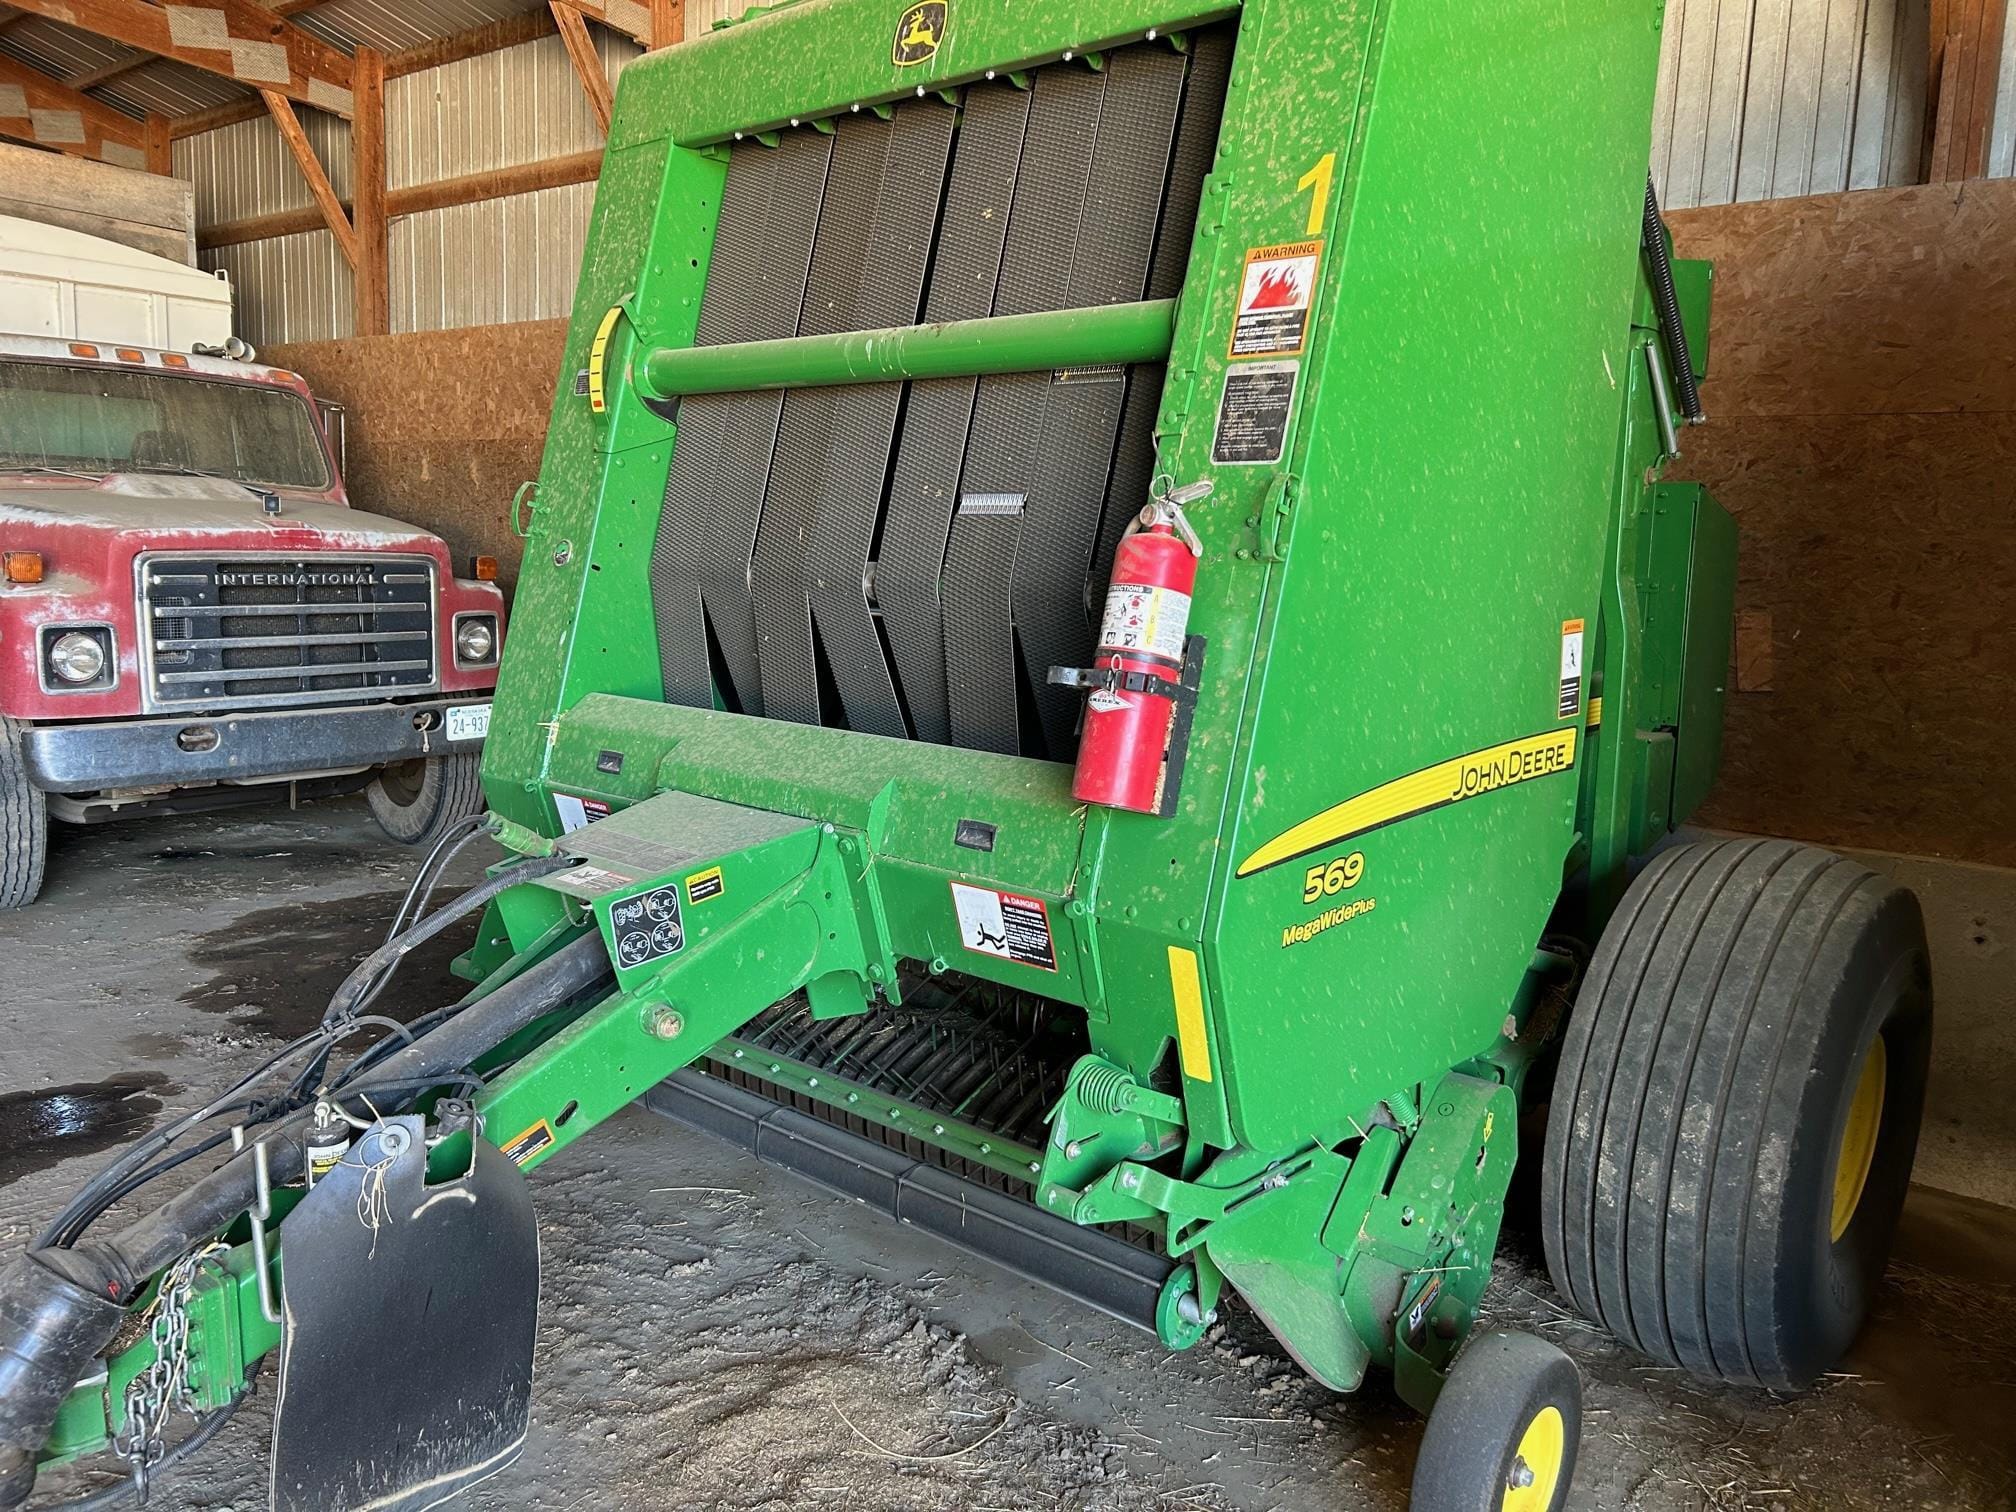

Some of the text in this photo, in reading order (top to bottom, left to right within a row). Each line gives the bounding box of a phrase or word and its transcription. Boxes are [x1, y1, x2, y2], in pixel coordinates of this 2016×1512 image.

[1297, 152, 1336, 235] 1
[1262, 243, 1315, 258] WARNING
[214, 574, 379, 585] INTERNATIONAL
[1452, 744, 1566, 796] JOHN DEERE
[1010, 896, 1041, 910] DANGER
[1302, 850, 1366, 905] 569
[1281, 897, 1376, 950] MegaWidePlus
